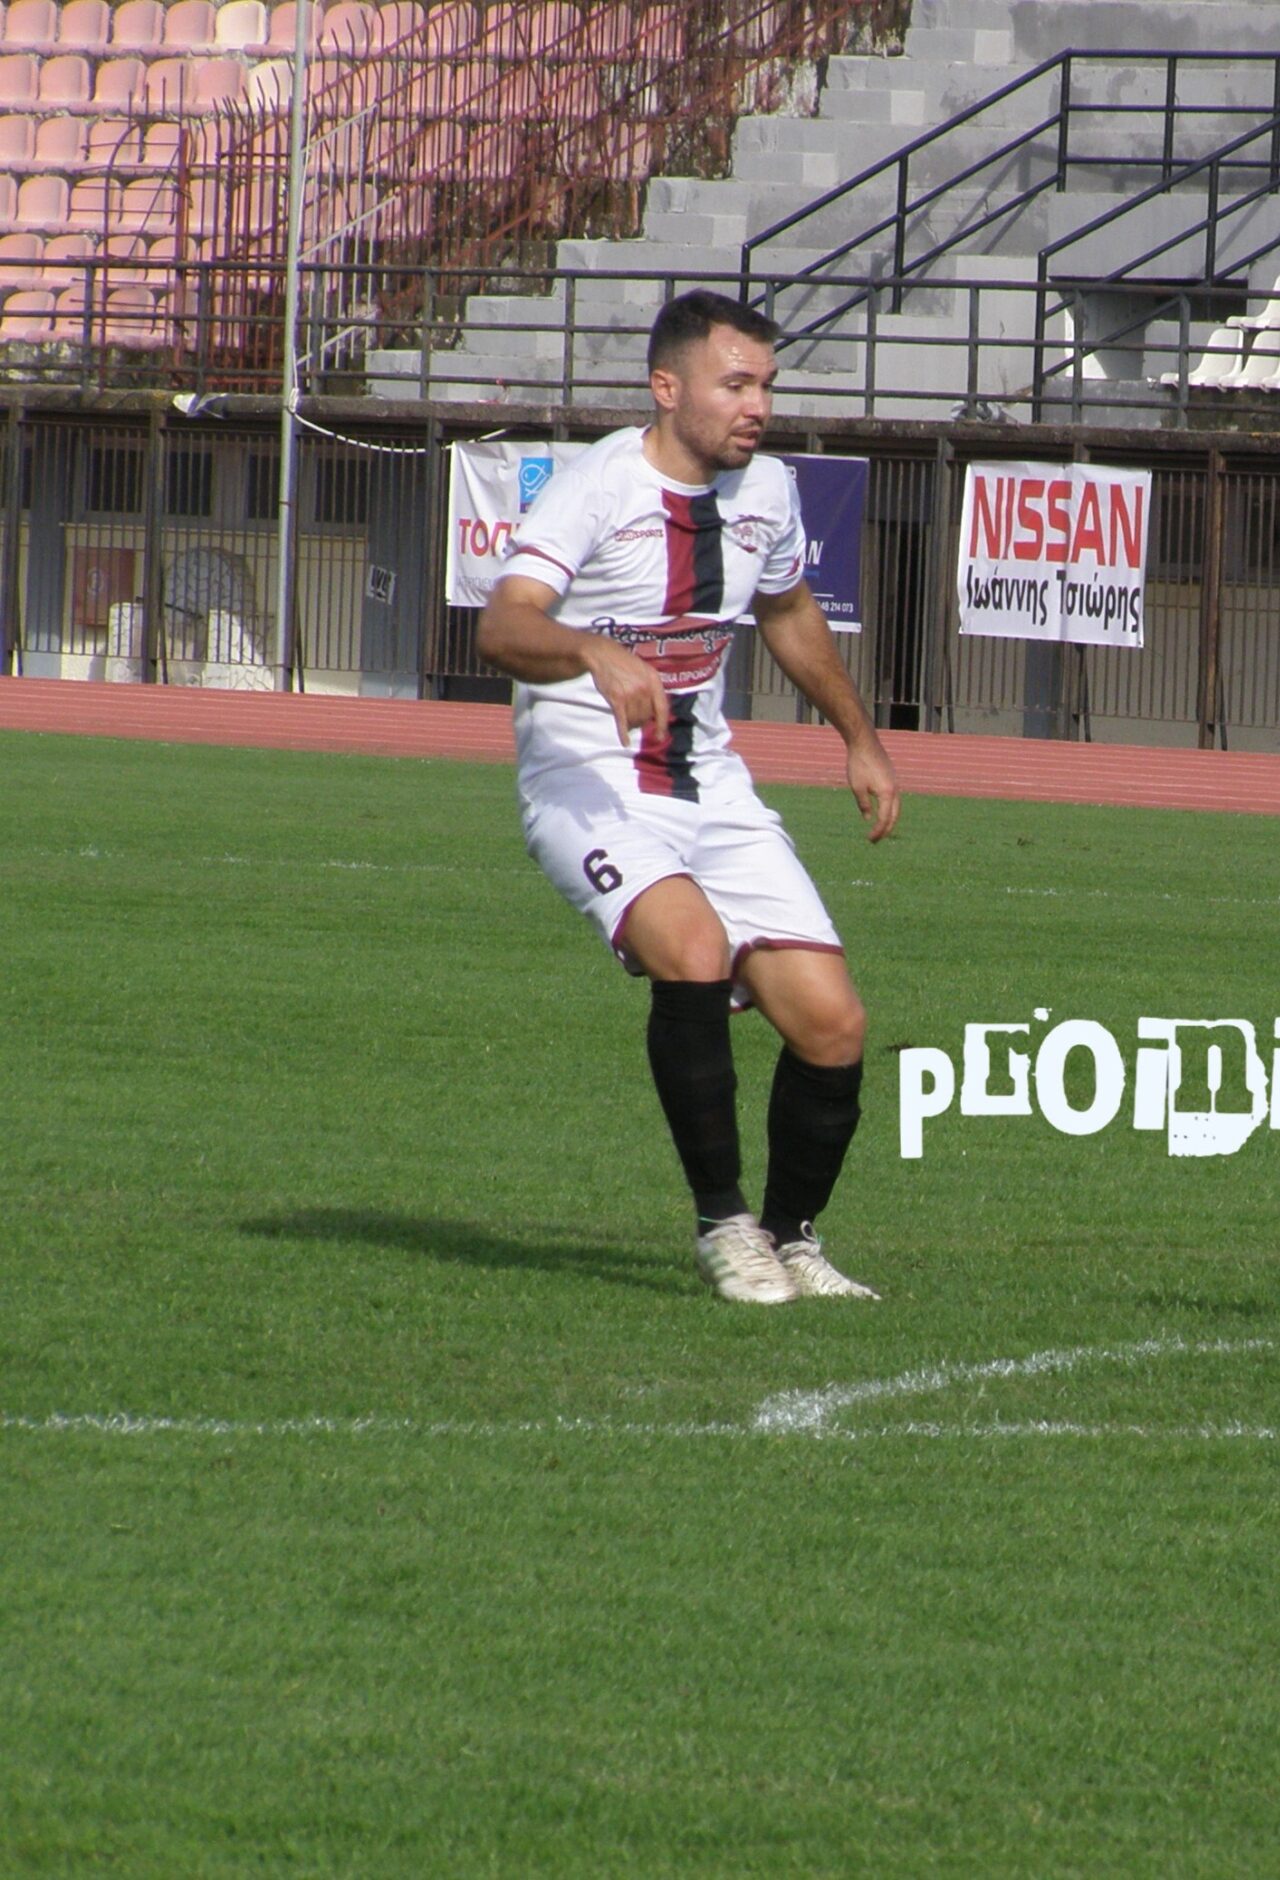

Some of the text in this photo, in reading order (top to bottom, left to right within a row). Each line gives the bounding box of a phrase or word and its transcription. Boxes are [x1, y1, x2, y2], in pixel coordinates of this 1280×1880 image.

[458, 518, 520, 558] ΤΟΠ
[969, 476, 1143, 568] NISSAN
[966, 565, 1141, 633] Ιωάννης Τσιώρης
[583, 848, 623, 895] 6
